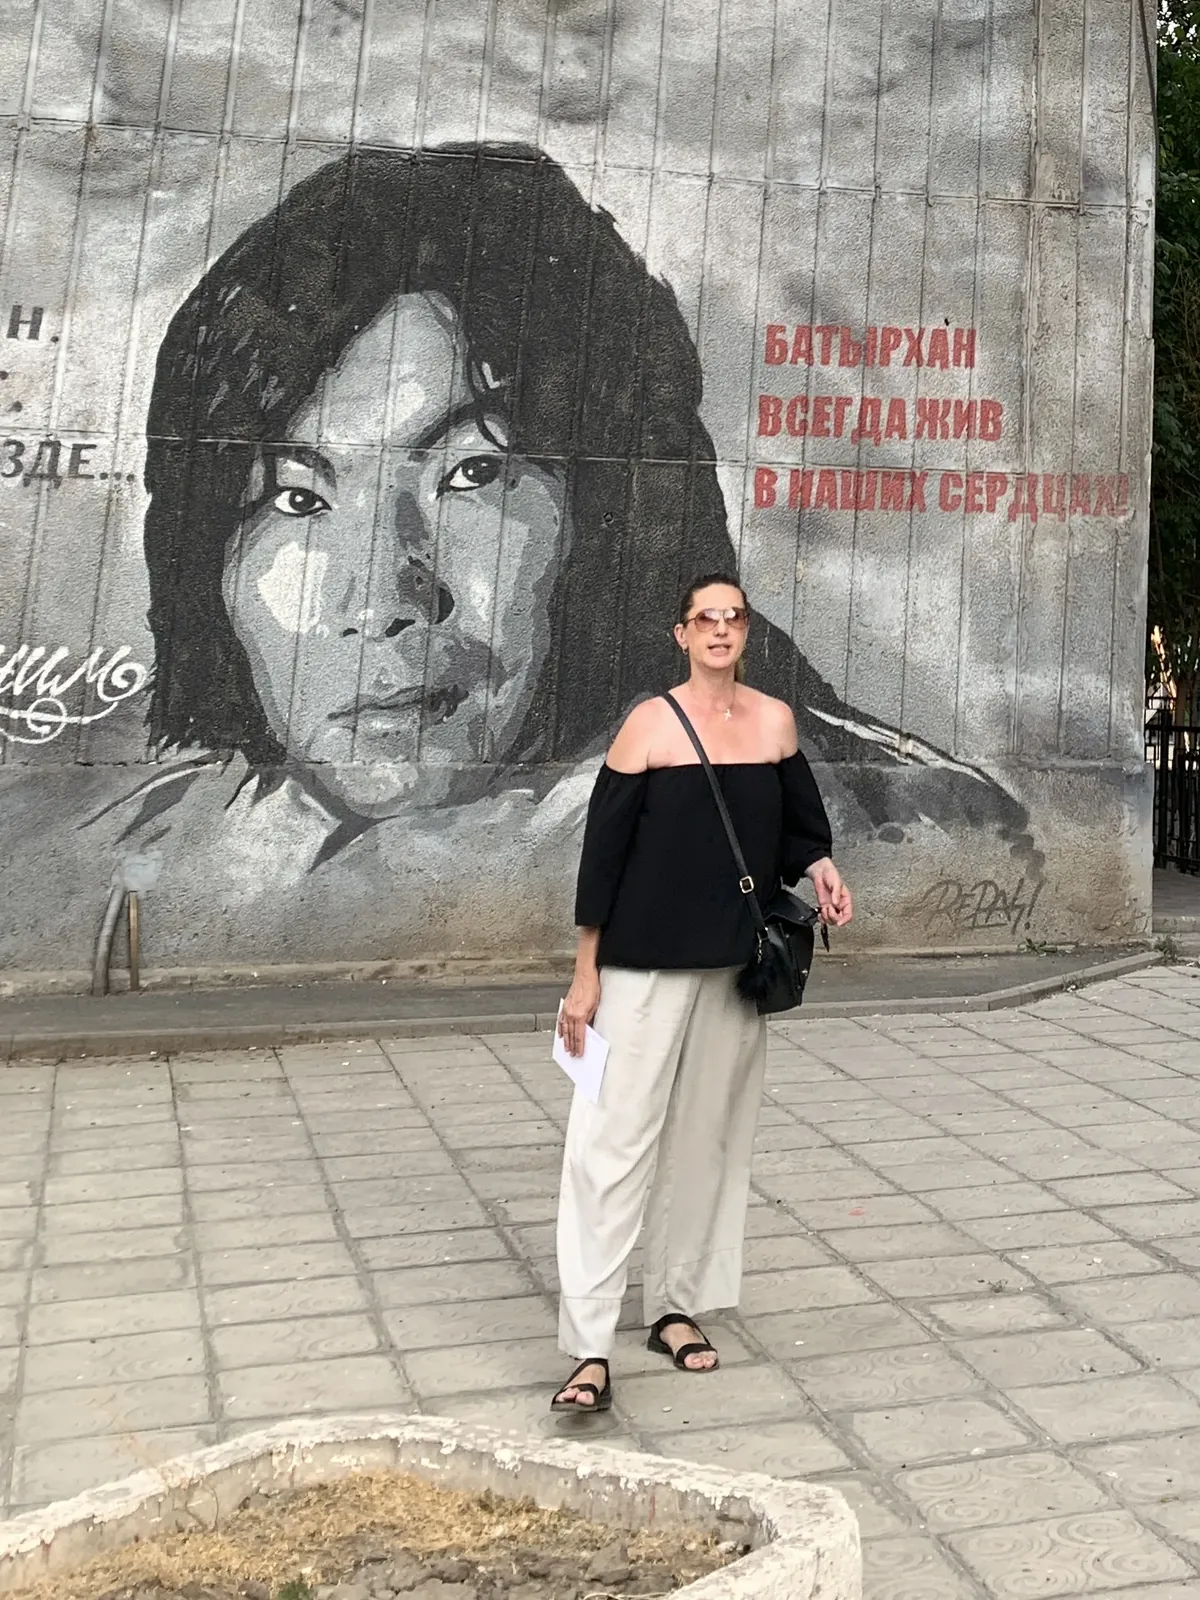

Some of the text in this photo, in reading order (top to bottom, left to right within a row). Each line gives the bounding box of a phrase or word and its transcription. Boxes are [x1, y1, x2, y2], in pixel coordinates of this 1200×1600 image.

[764, 324, 977, 371] БАТЫРХАН
[758, 395, 1003, 446] ВСЕГДА ЖИВ
[754, 467, 778, 509] В
[789, 468, 928, 512] НАШИХ
